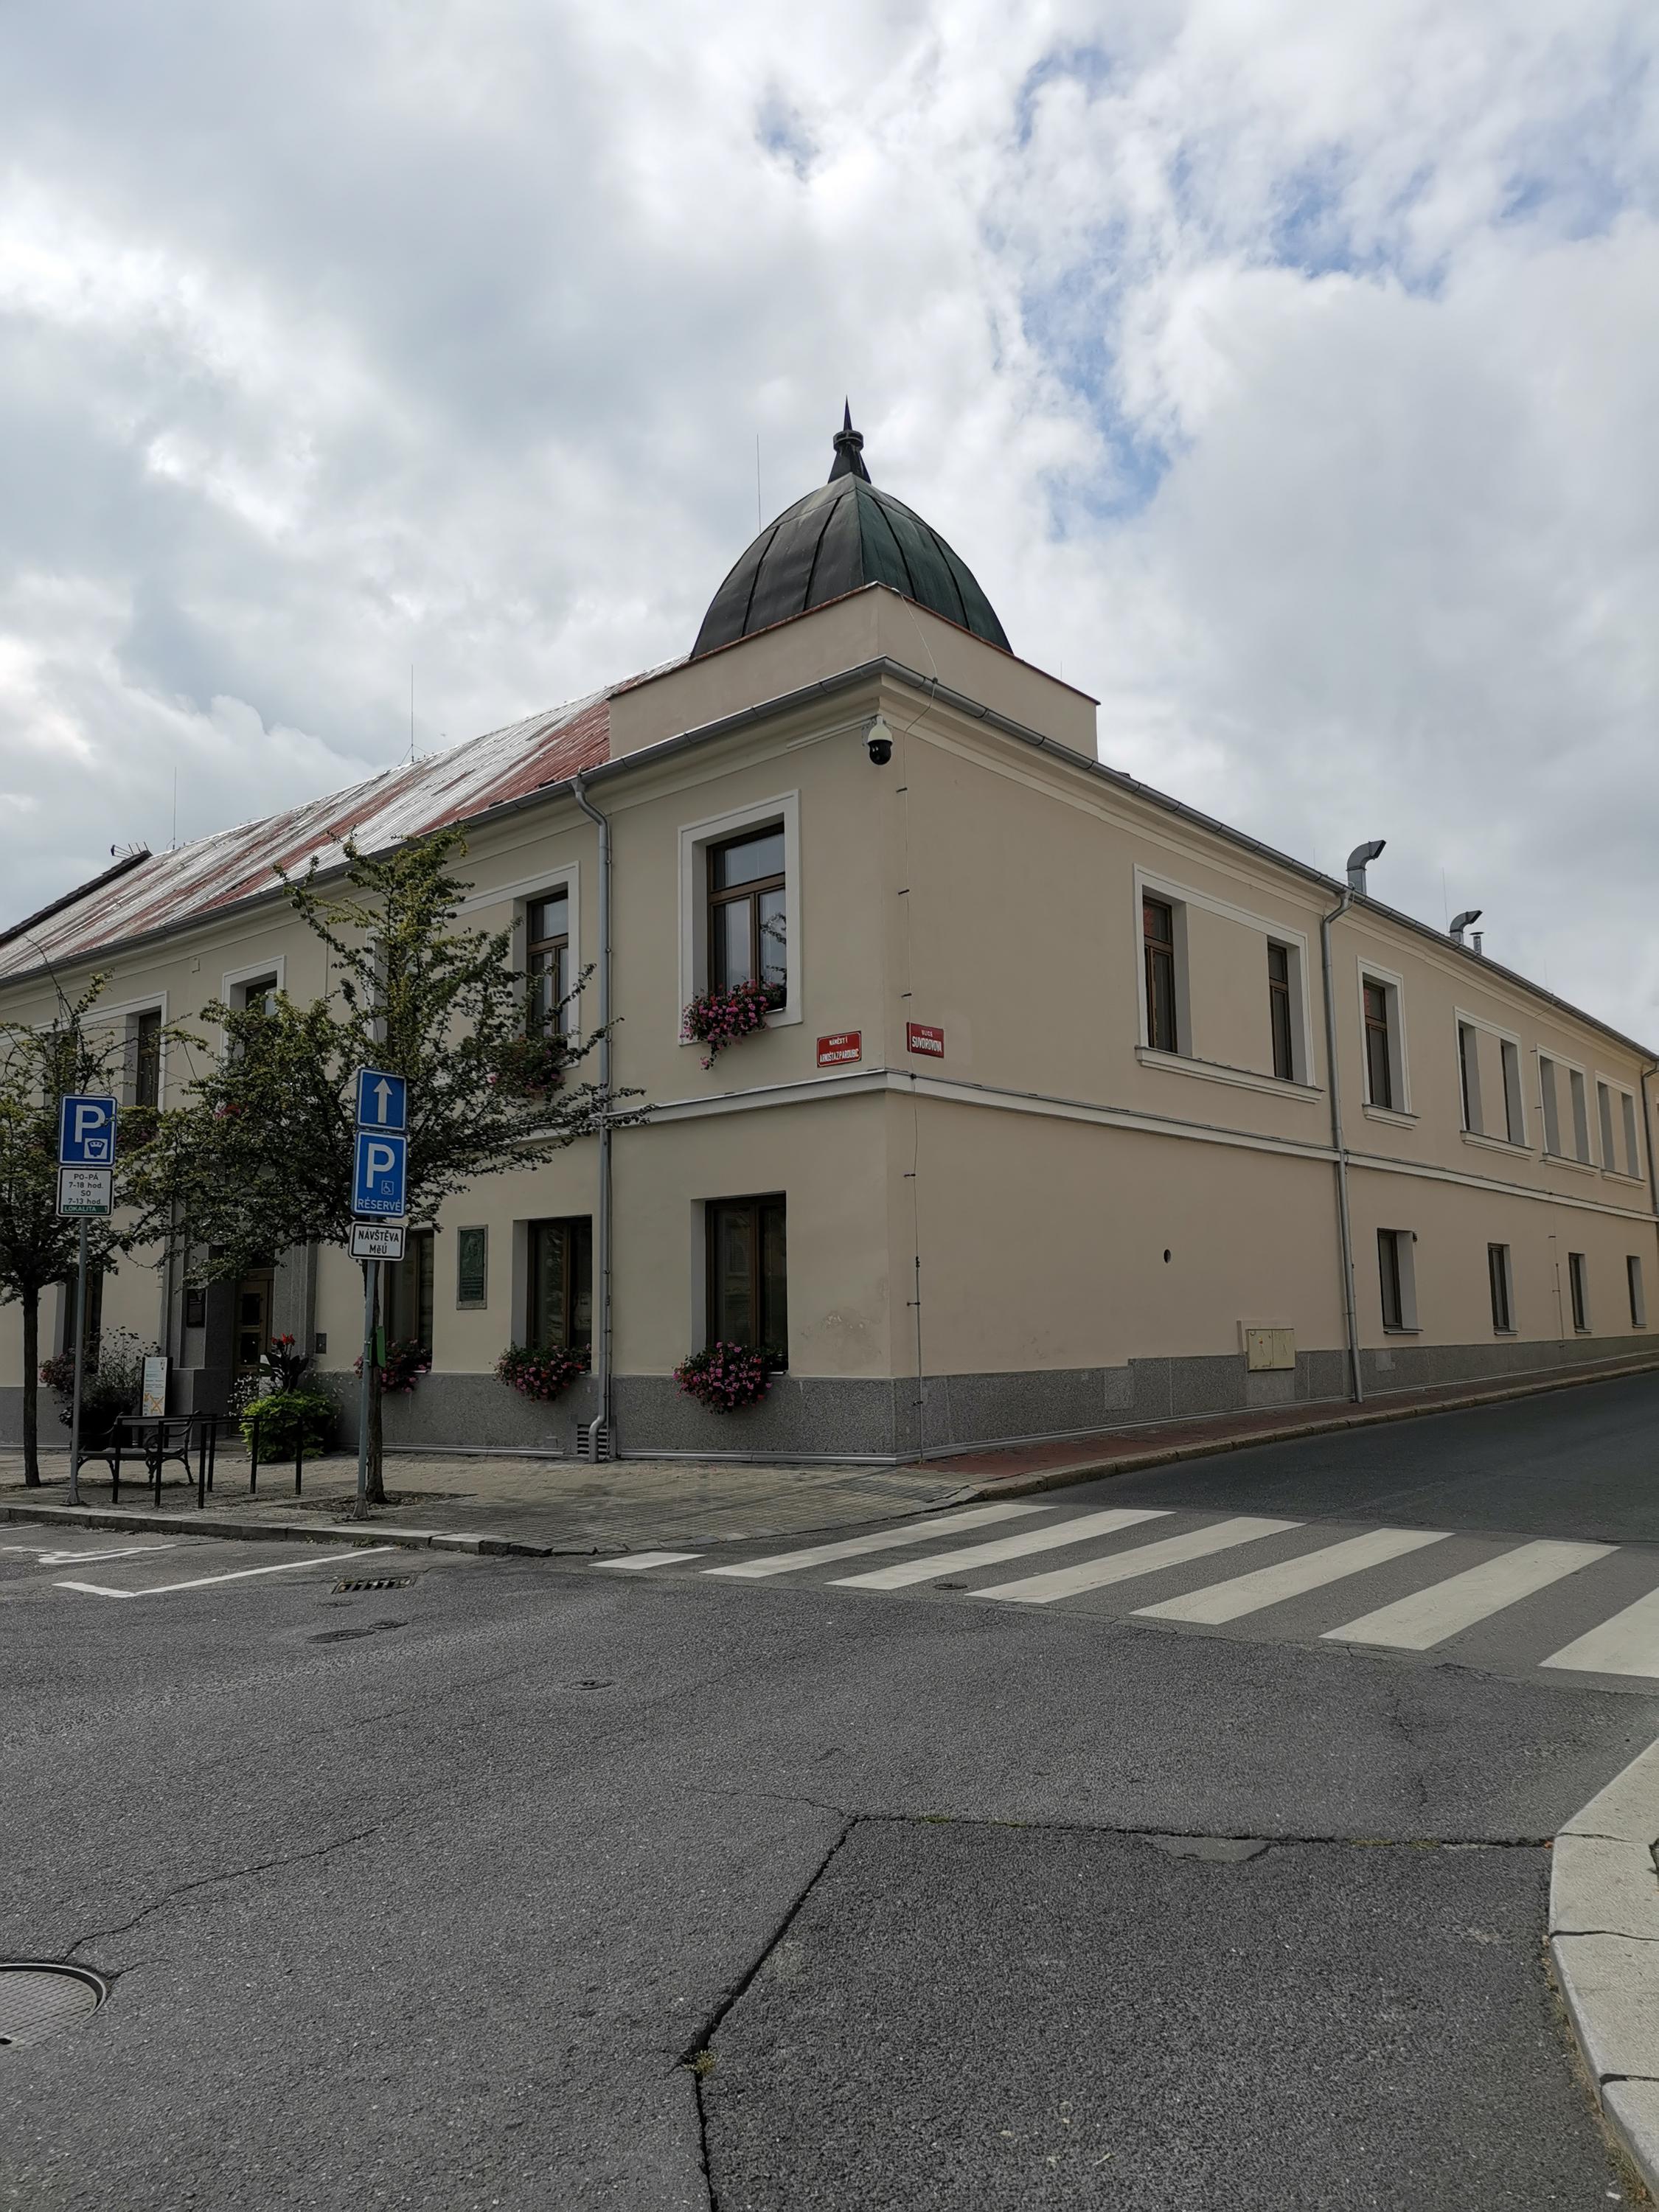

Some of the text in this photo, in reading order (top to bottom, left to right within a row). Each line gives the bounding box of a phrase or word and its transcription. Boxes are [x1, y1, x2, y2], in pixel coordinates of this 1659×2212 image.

[912, 1036, 942, 1052] SUVOROVOVA
[839, 1048, 859, 1060] PARDUBIC
[74, 1105, 105, 1142] P
[366, 1143, 395, 1188] P
[74, 1172, 99, 1180] PO-PÁ
[358, 1196, 401, 1211] RÉSERVÉ
[358, 1228, 399, 1242] NÁVŠTĚVA
[369, 1242, 387, 1254] MěÚ
